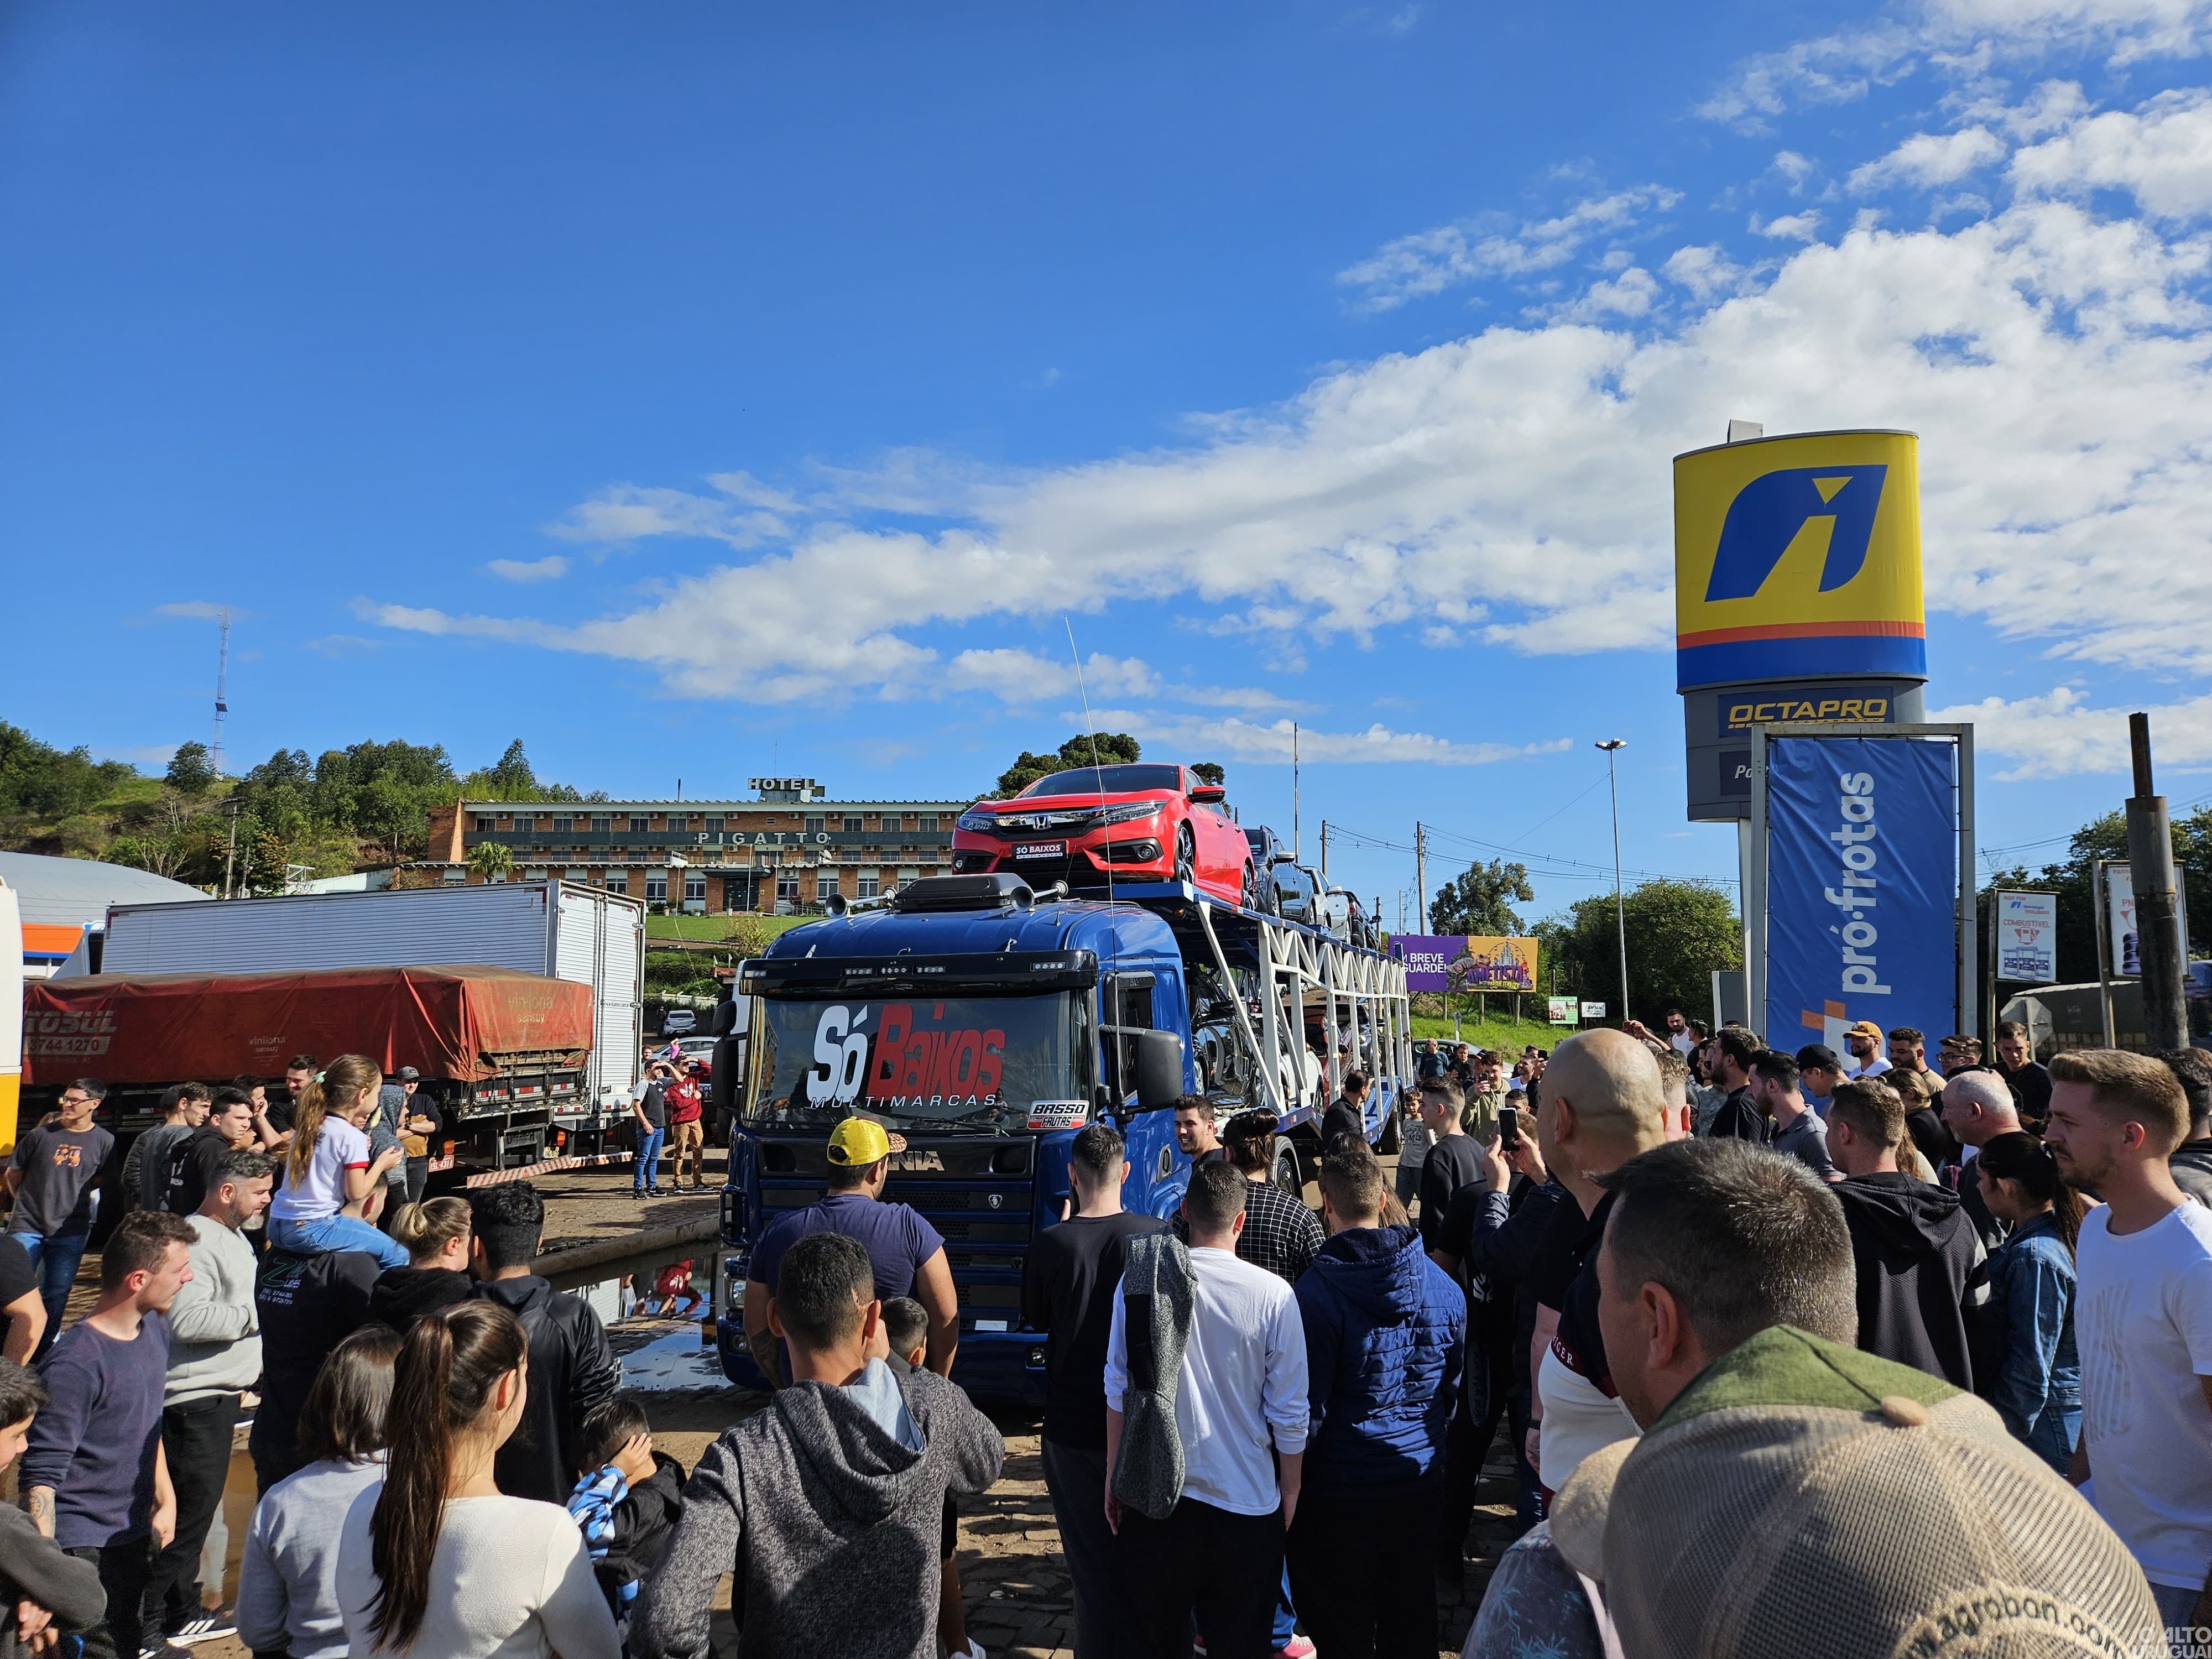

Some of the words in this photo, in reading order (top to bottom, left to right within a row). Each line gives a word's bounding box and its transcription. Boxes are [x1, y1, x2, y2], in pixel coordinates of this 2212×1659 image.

[1729, 699, 1887, 722] OCTAPRO
[748, 779, 816, 790] HOTEL
[698, 832, 828, 845] PIGATTO
[1016, 845, 1028, 854] SÓ
[1029, 844, 1061, 853] BAIXOS
[1410, 953, 1444, 963] BREVE
[1404, 963, 1447, 973] GUARDE!
[1467, 965, 1523, 983] AMETISTA
[30, 1039, 62, 1051] 3744
[67, 1038, 100, 1051] 1270
[807, 1005, 868, 1103] Só
[866, 1002, 1006, 1101] Baixos
[810, 1094, 996, 1108] MULTIMARCAS
[1033, 1104, 1086, 1114] BASSO
[1041, 1117, 1072, 1127] FRUTAS
[888, 1151, 945, 1171] NIA
